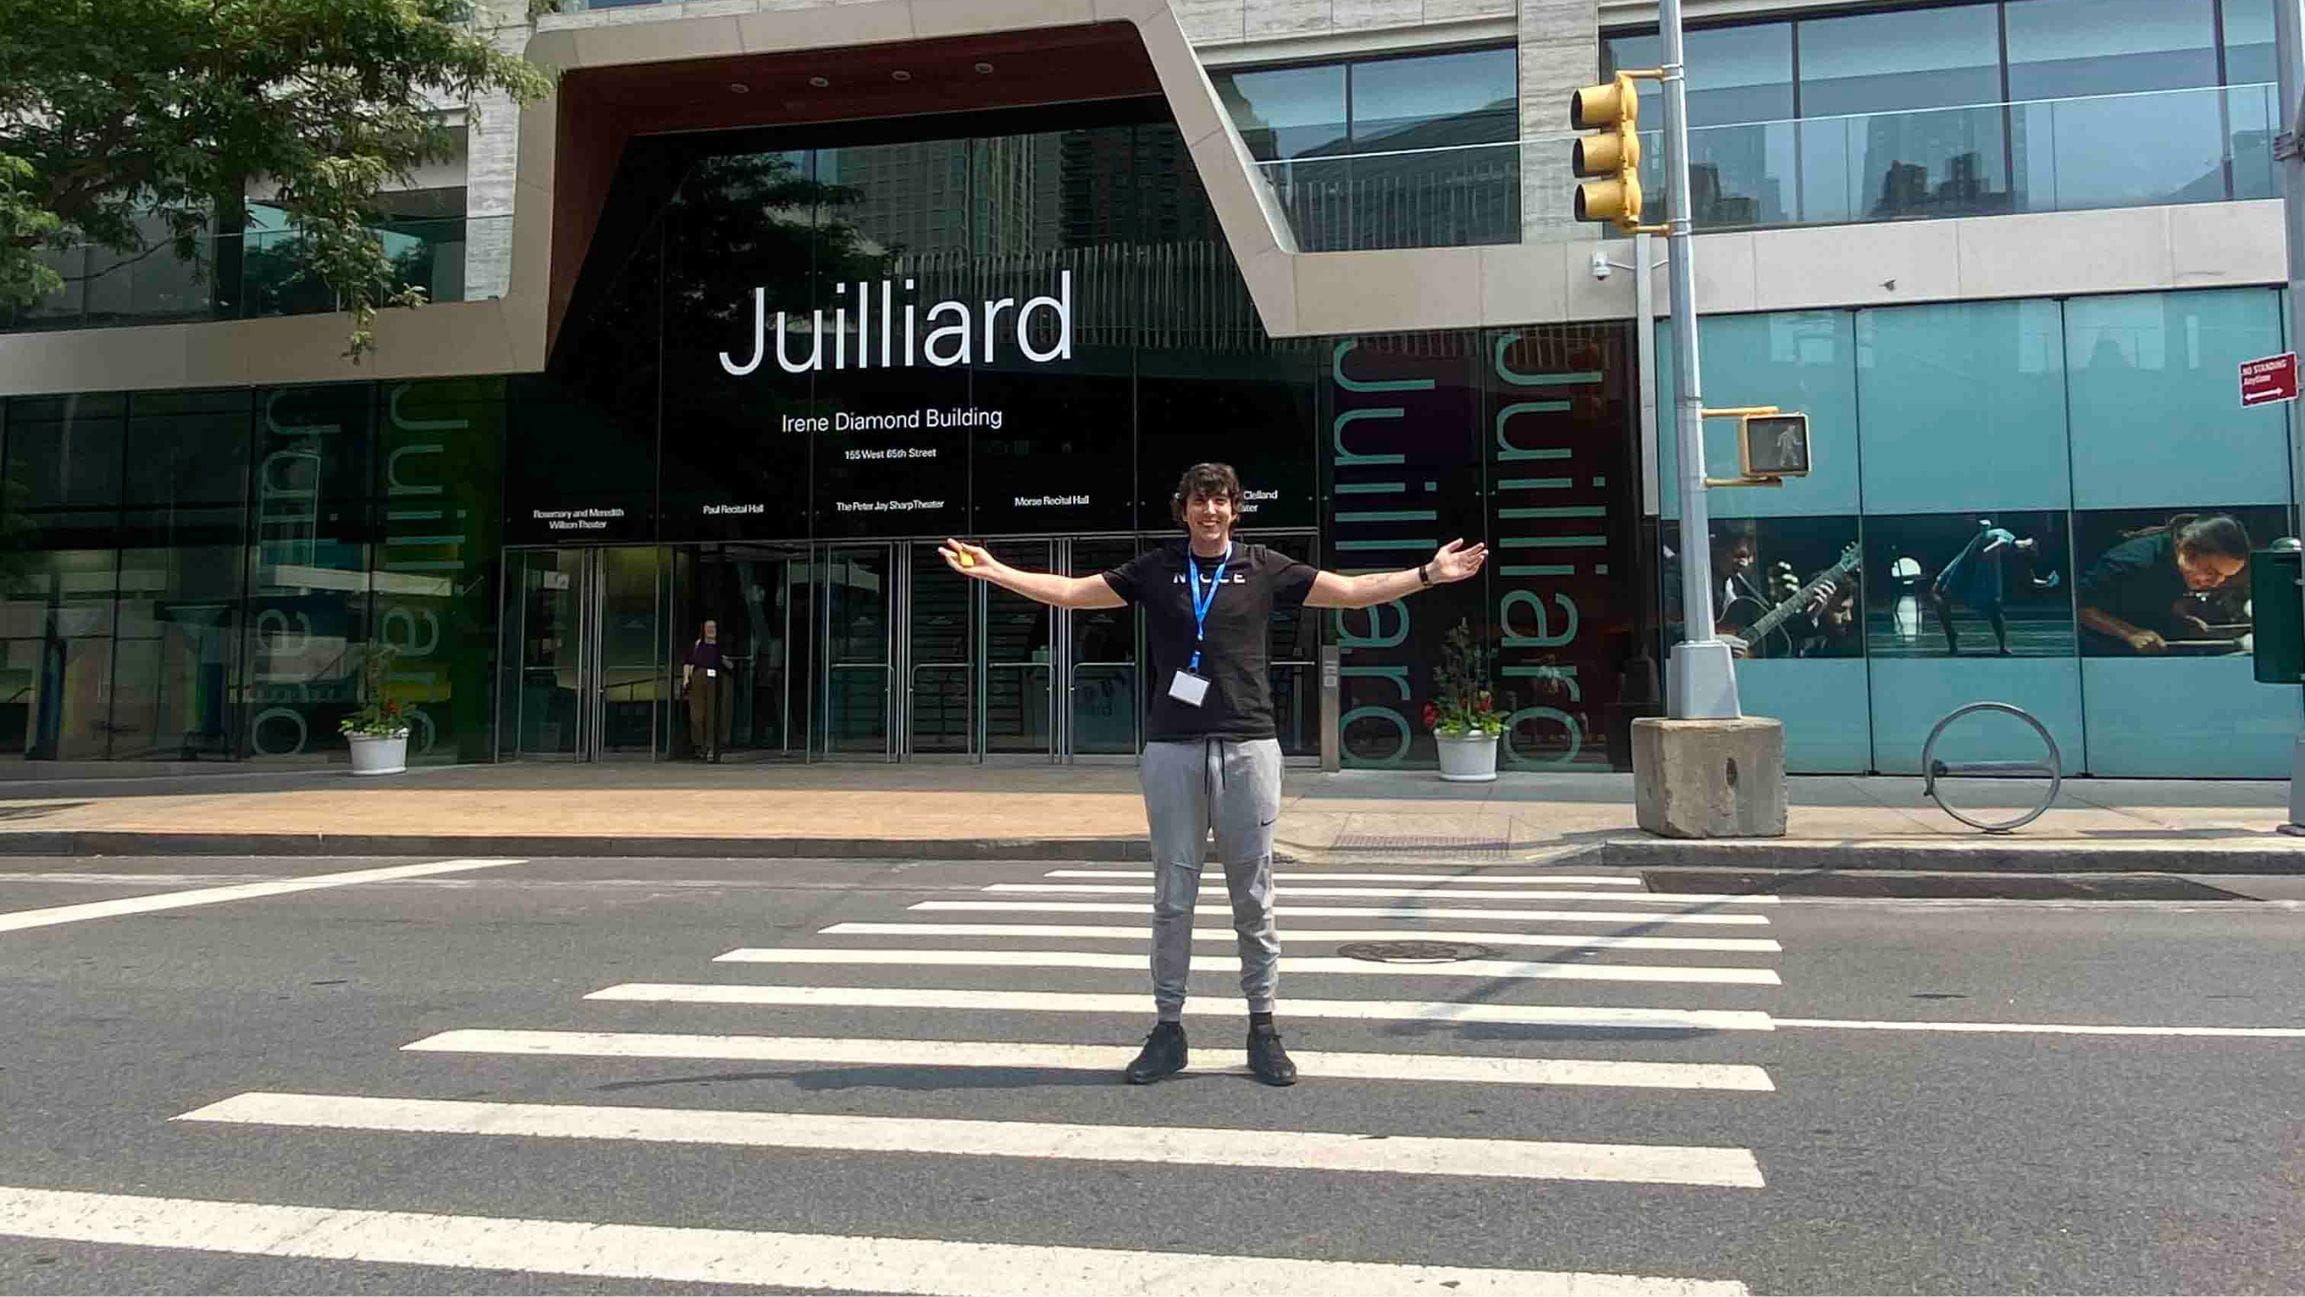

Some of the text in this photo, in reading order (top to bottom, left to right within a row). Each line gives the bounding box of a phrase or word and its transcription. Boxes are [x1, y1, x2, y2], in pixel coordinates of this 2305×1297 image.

[719, 269, 1071, 375] Juilliard
[782, 407, 1003, 433] Irene Diamond Building
[844, 447, 937, 460] 155 West 65th Street
[835, 499, 945, 512] The Peter Jay Sharp Theater
[1014, 494, 1090, 507] Morse Recital Hall
[572, 508, 588, 518] and
[702, 503, 765, 515] Paul Recital Hall
[578, 519, 608, 529] Theater
[1332, 338, 1438, 768] Juillard
[1494, 331, 1618, 770] Juilliard
